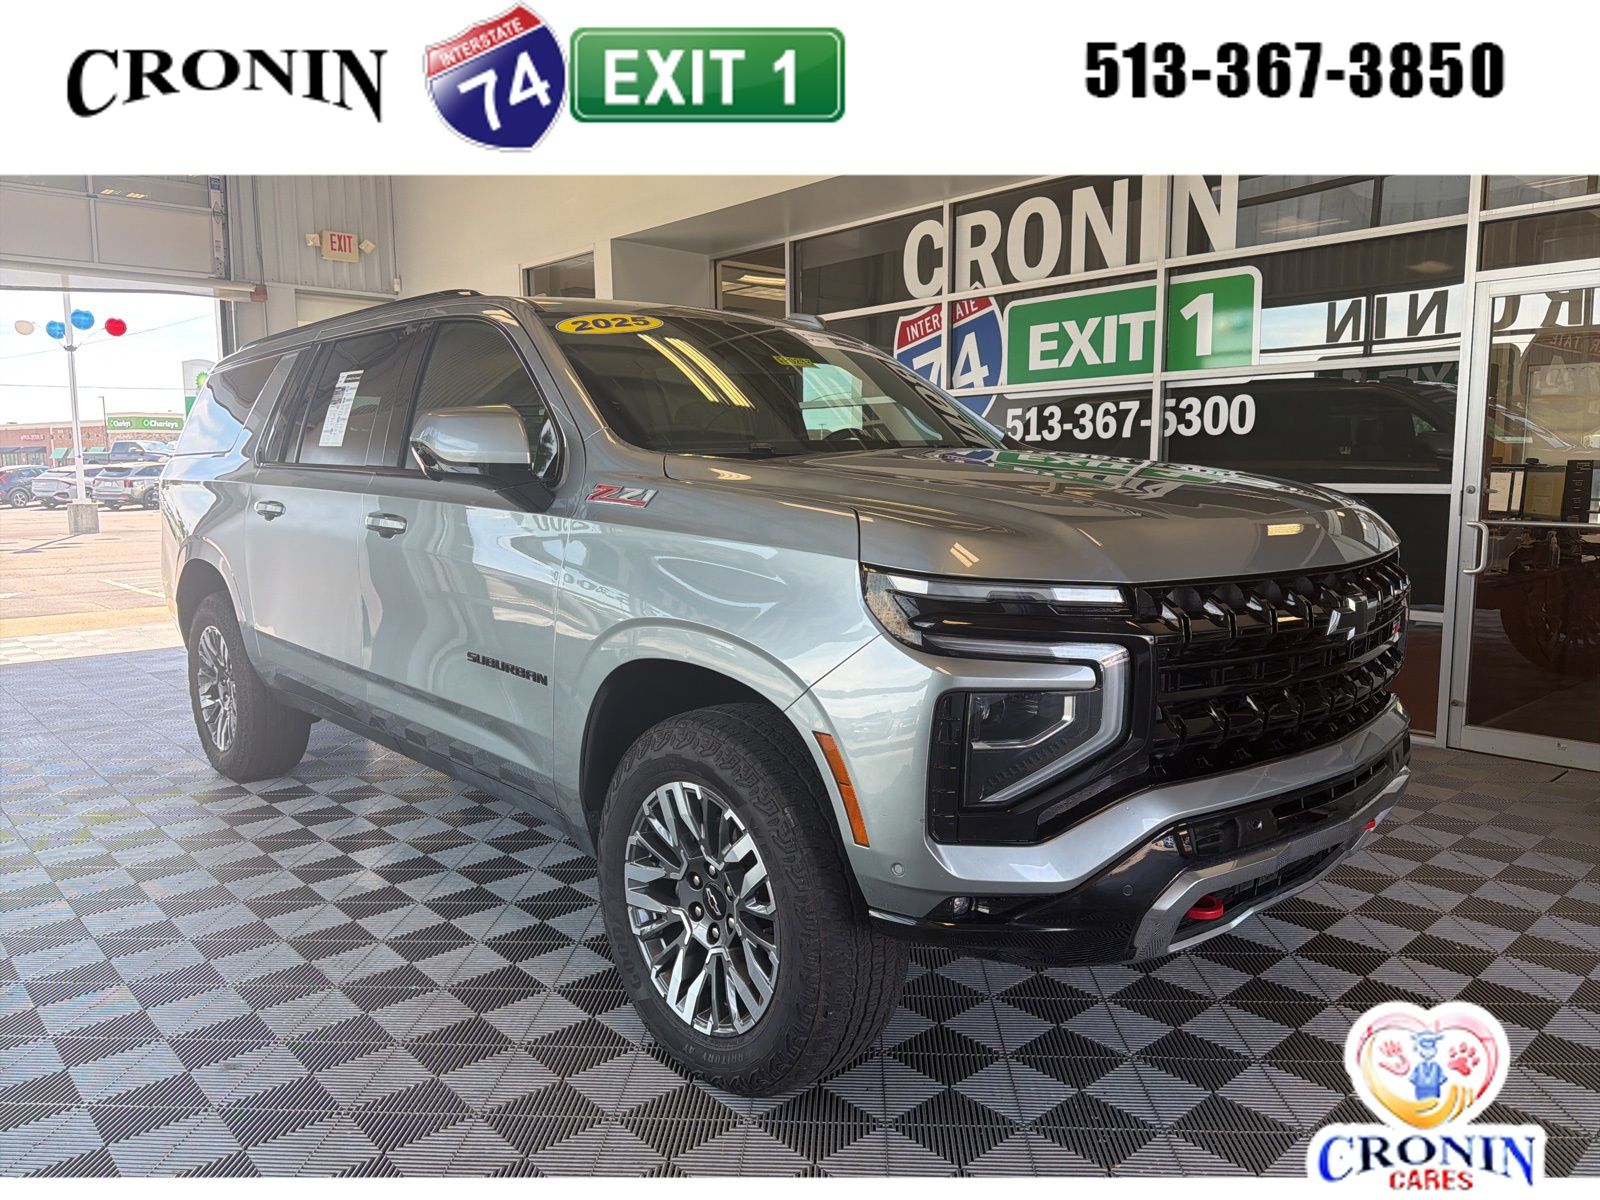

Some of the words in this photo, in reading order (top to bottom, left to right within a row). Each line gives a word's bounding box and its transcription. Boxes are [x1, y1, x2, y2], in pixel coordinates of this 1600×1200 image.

[330, 233, 352, 253] EXIT
[903, 174, 1239, 299] CRONIN
[571, 316, 650, 332] 2025
[906, 299, 979, 342] INTERATE
[1029, 309, 1155, 371] EXIT
[1180, 293, 1214, 357] 1
[912, 331, 989, 389] 74
[1006, 393, 1256, 443] 513-367-5300
[585, 483, 659, 509] Z71
[466, 650, 548, 687] SUBURBAN
